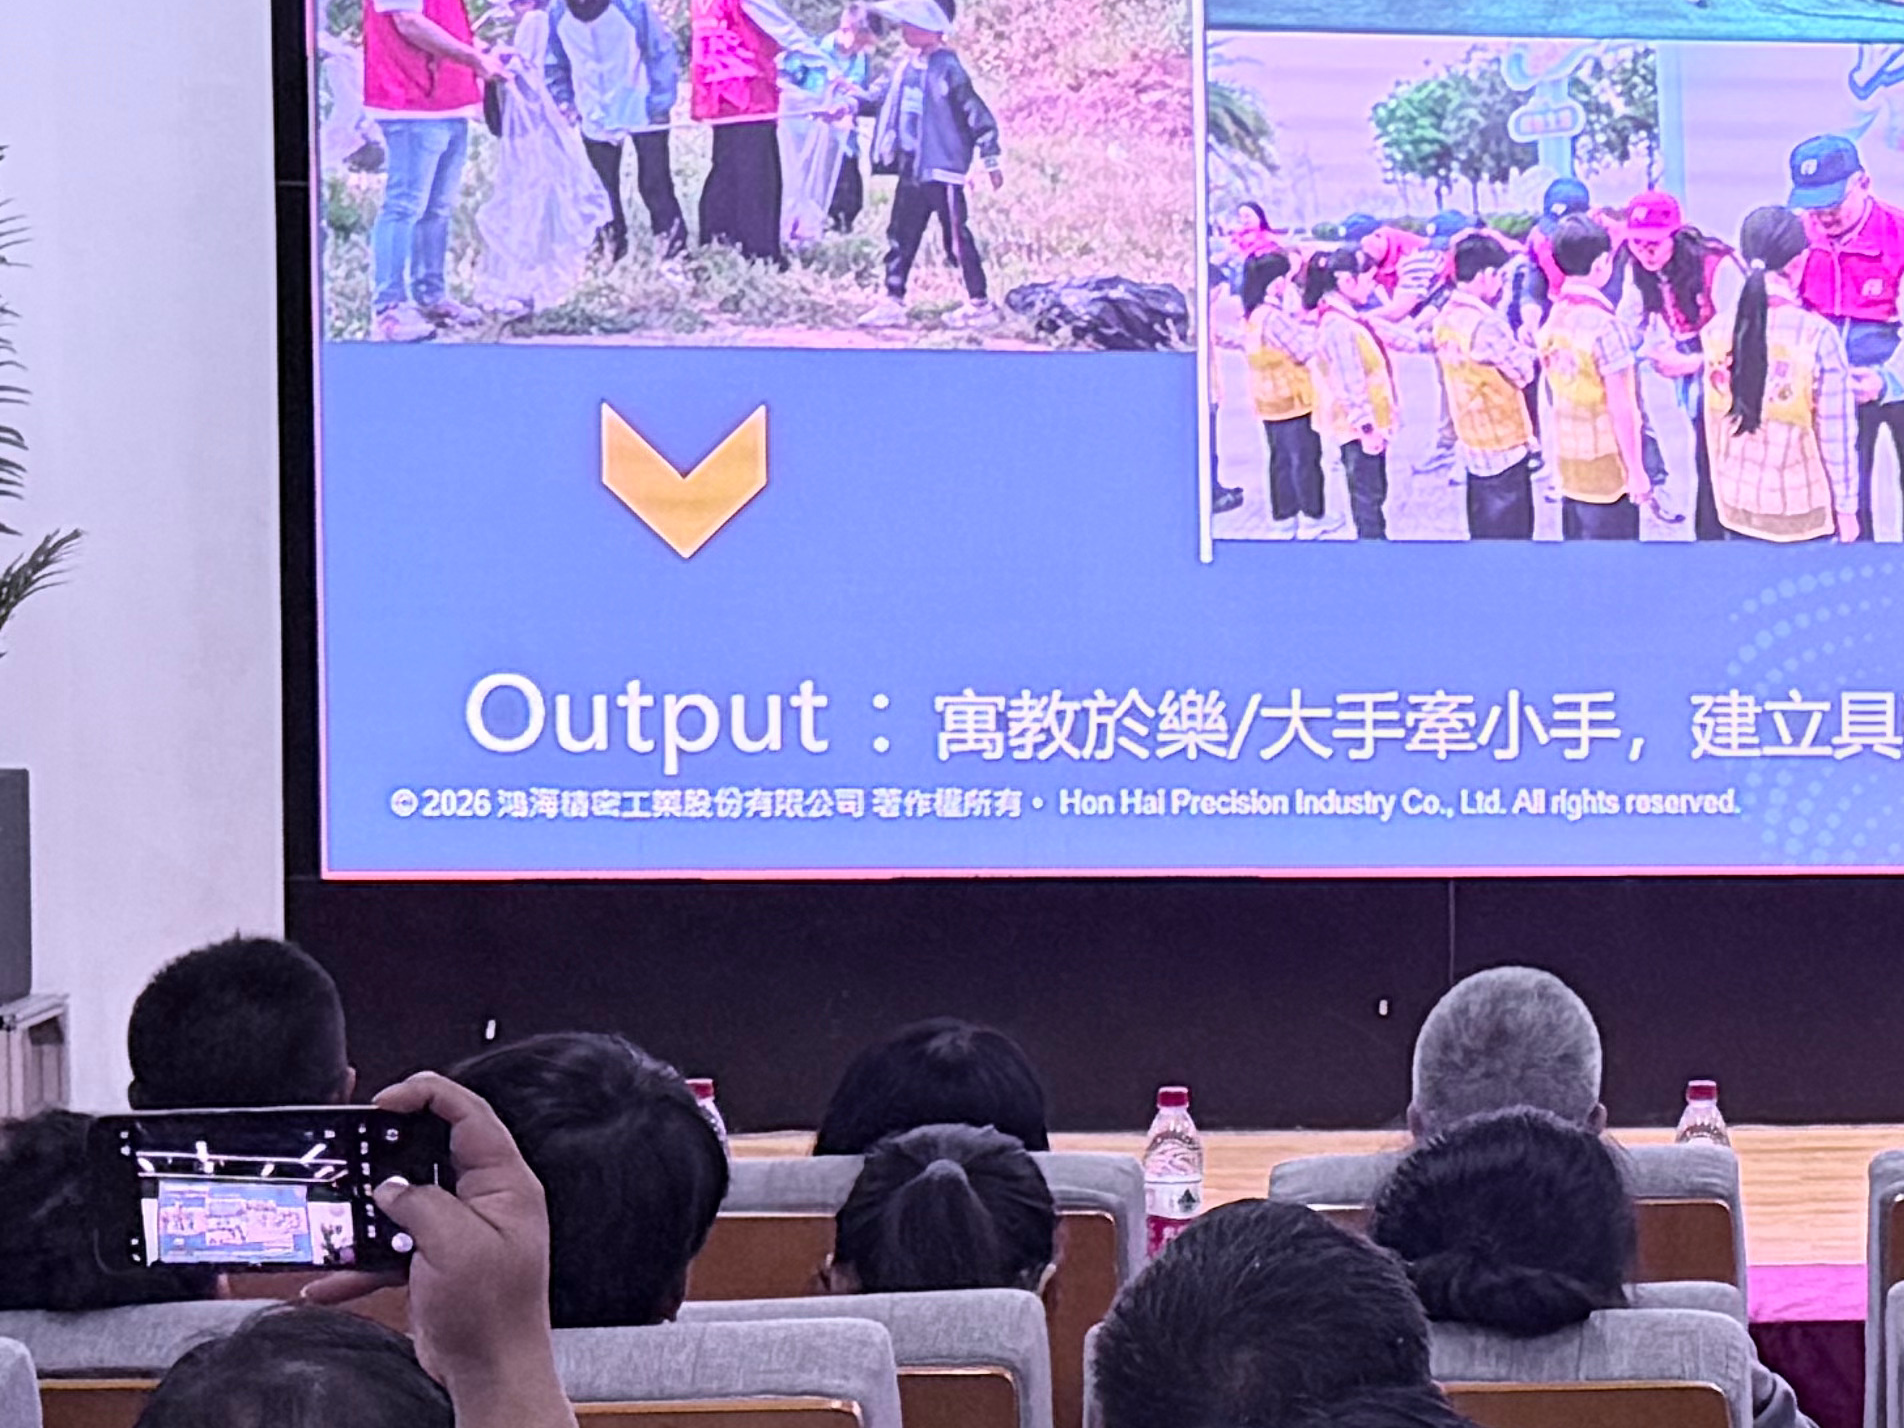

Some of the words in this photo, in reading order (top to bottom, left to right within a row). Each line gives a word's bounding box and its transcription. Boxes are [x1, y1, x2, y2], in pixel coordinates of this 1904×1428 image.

[421, 788, 492, 818] 2026
[1059, 788, 1115, 816] Hon
[1120, 788, 1166, 816] Hai
[1170, 788, 1290, 816] Precision
[1295, 788, 1396, 822] Industry
[1401, 789, 1454, 821] Co.,
[1460, 789, 1507, 816] Ltd.
[1512, 789, 1547, 816] All
[1551, 789, 1621, 822] rights
[1626, 790, 1741, 816] reserved.
